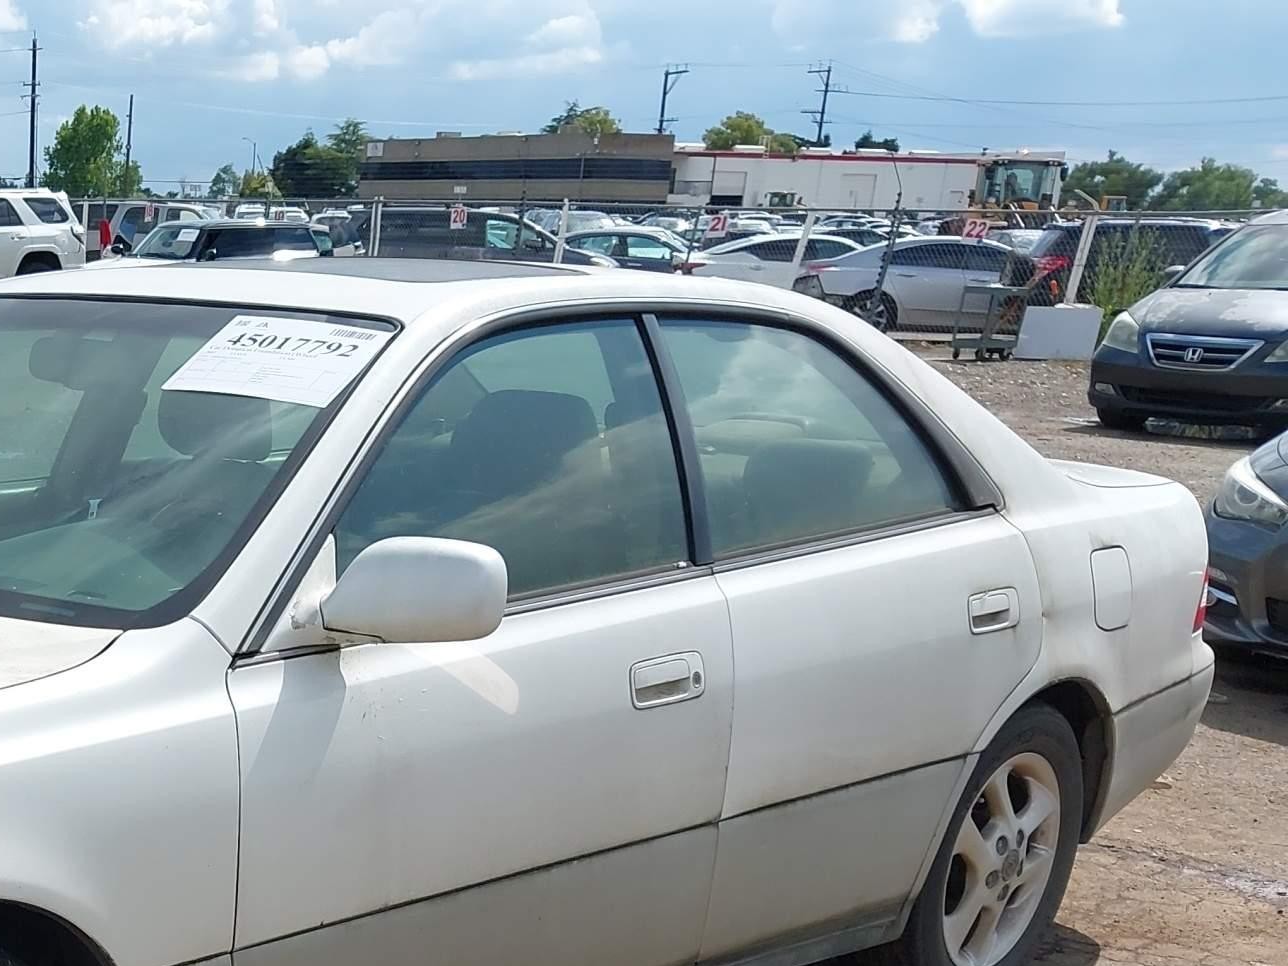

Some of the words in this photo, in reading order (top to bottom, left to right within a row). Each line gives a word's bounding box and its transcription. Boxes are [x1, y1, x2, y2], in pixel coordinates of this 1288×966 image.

[453, 210, 465, 223] 20
[709, 216, 727, 231] 21
[966, 221, 987, 238] 22
[227, 332, 360, 358] 45017792
